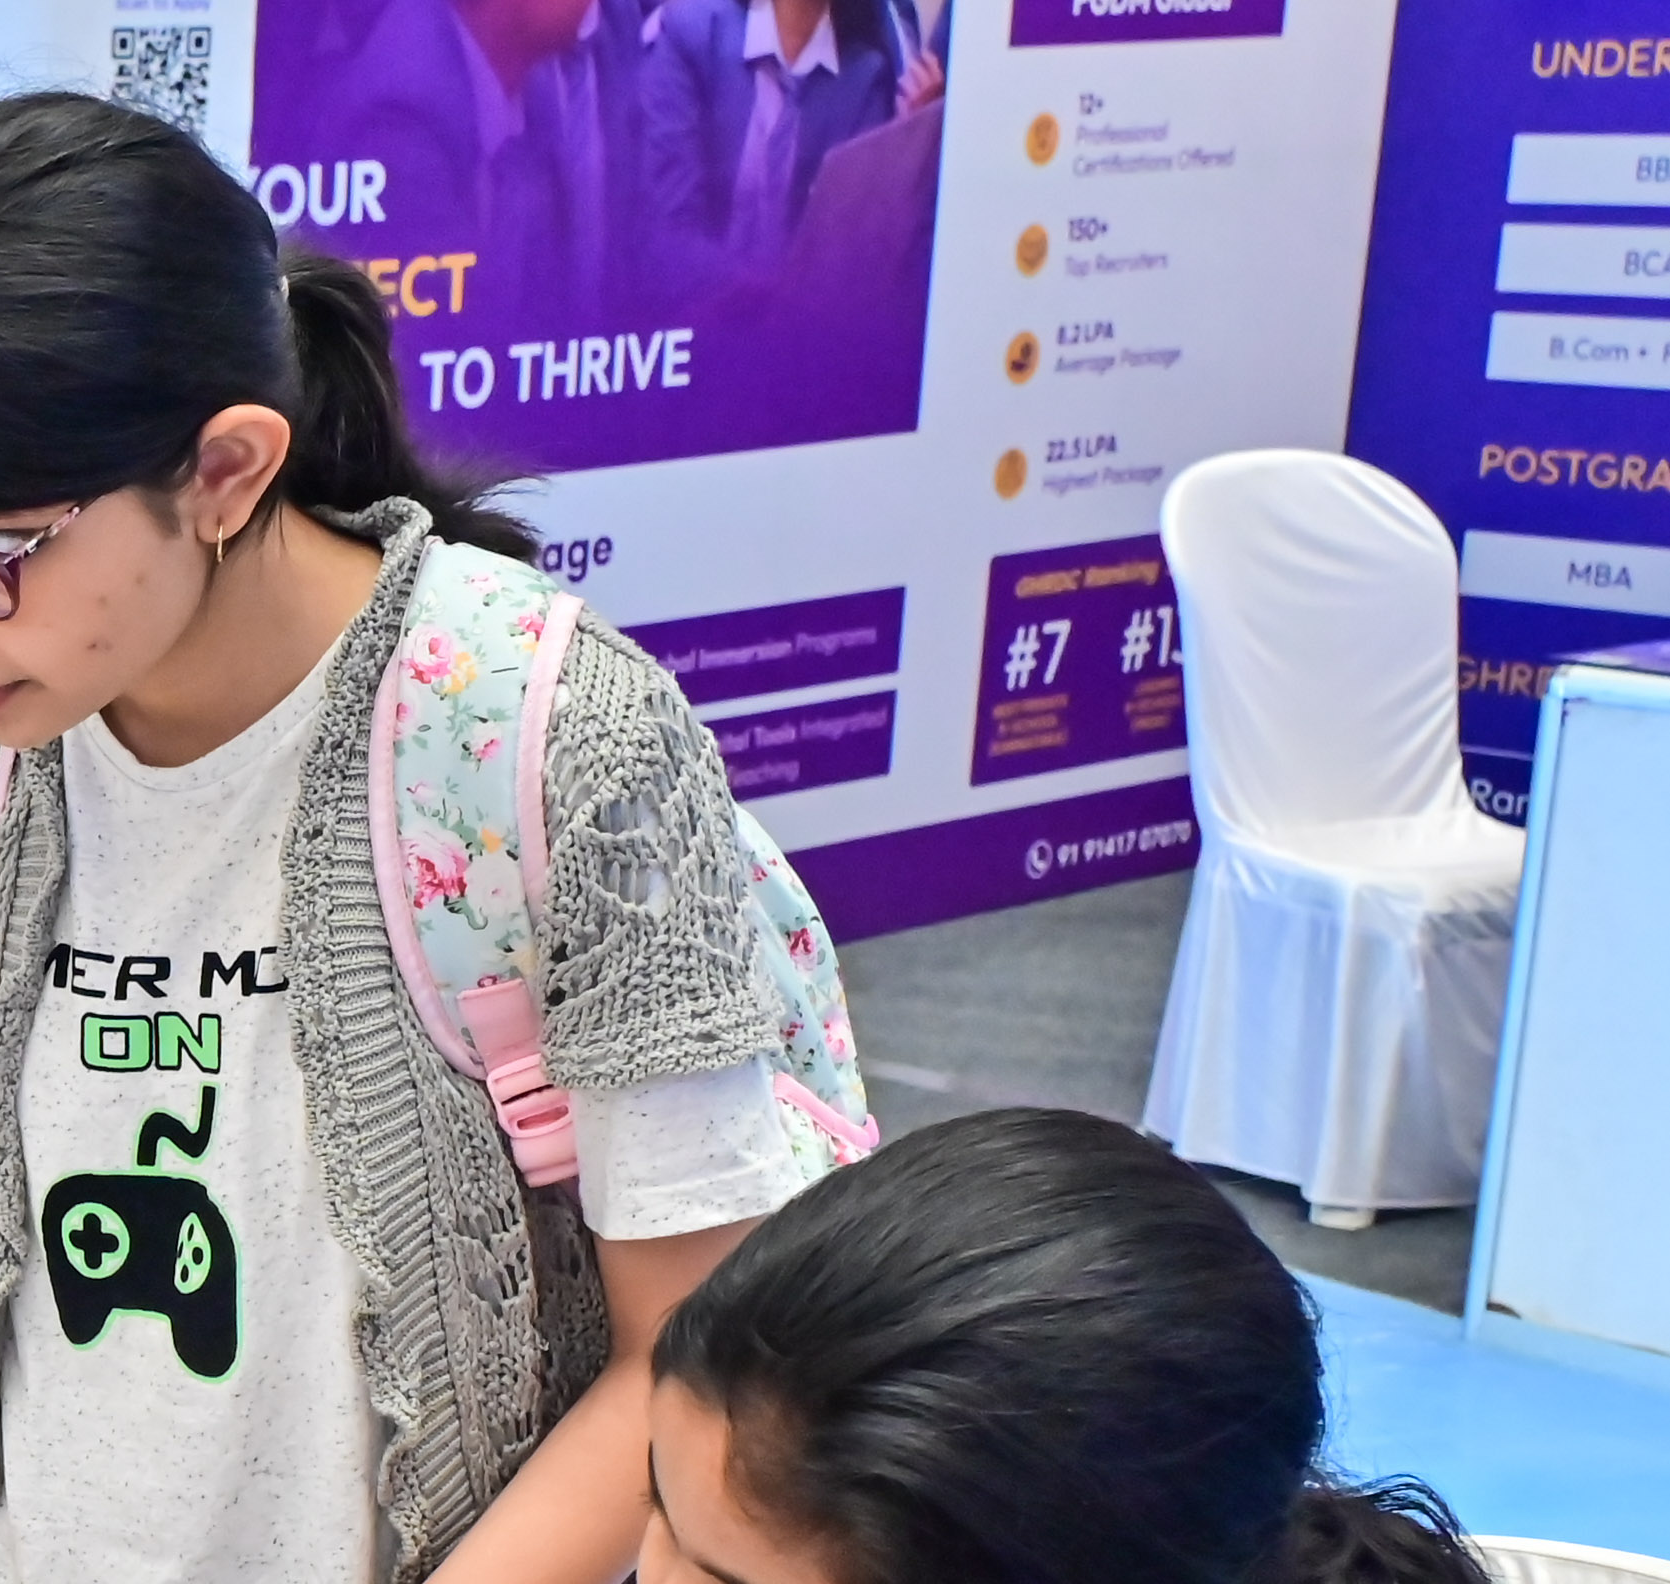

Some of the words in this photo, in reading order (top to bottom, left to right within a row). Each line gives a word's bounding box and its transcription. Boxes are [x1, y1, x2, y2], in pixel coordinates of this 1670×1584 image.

[363, 253, 478, 318] ECT
[420, 347, 494, 412] TO
[508, 328, 694, 403] THRIVE
[1567, 560, 1634, 592] MBA
[1004, 617, 1072, 692] #7
[80, 1011, 222, 1075] ON
